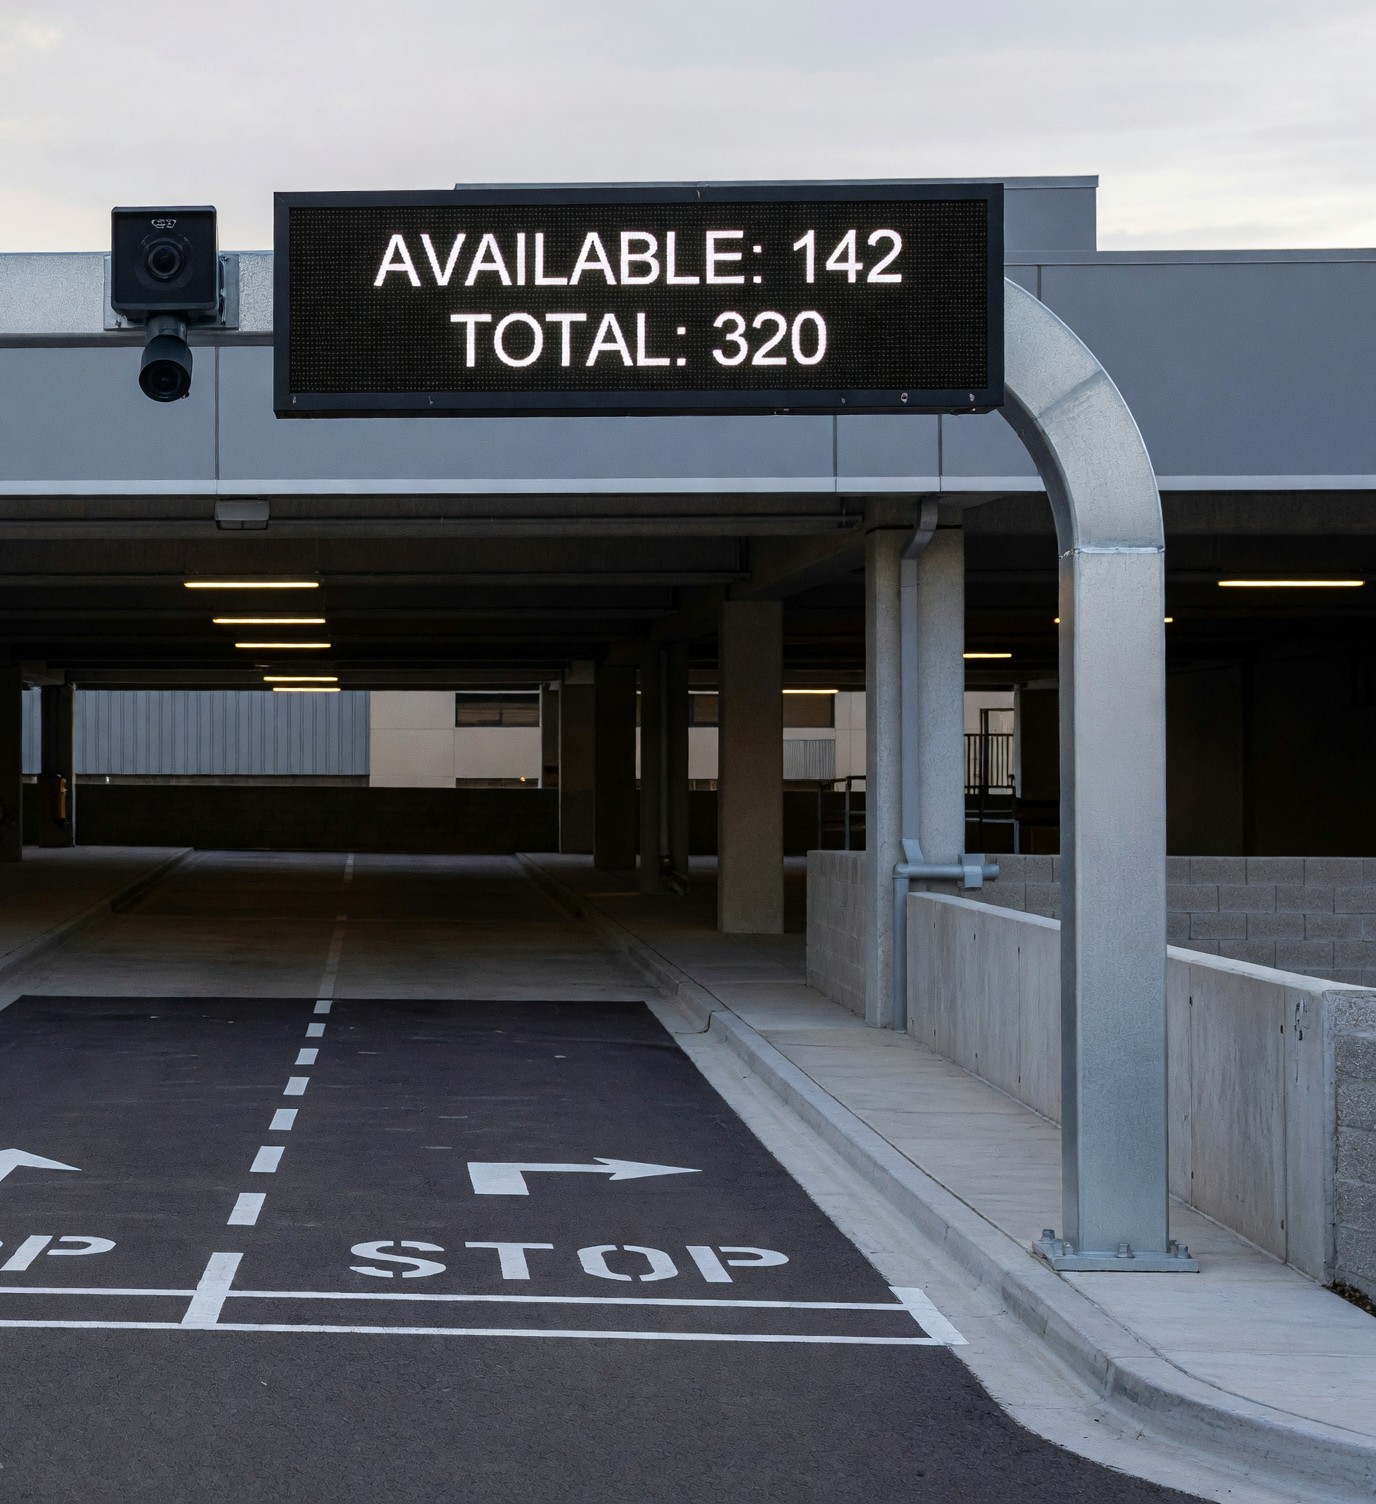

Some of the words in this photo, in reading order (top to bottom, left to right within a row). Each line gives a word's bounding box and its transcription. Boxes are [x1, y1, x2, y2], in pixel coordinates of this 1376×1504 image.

[373, 230, 763, 287] AVAILABLE:
[793, 229, 904, 284] 142
[450, 312, 687, 368] TOTAL:
[712, 310, 828, 366] 320
[349, 1240, 790, 1283] STOP
